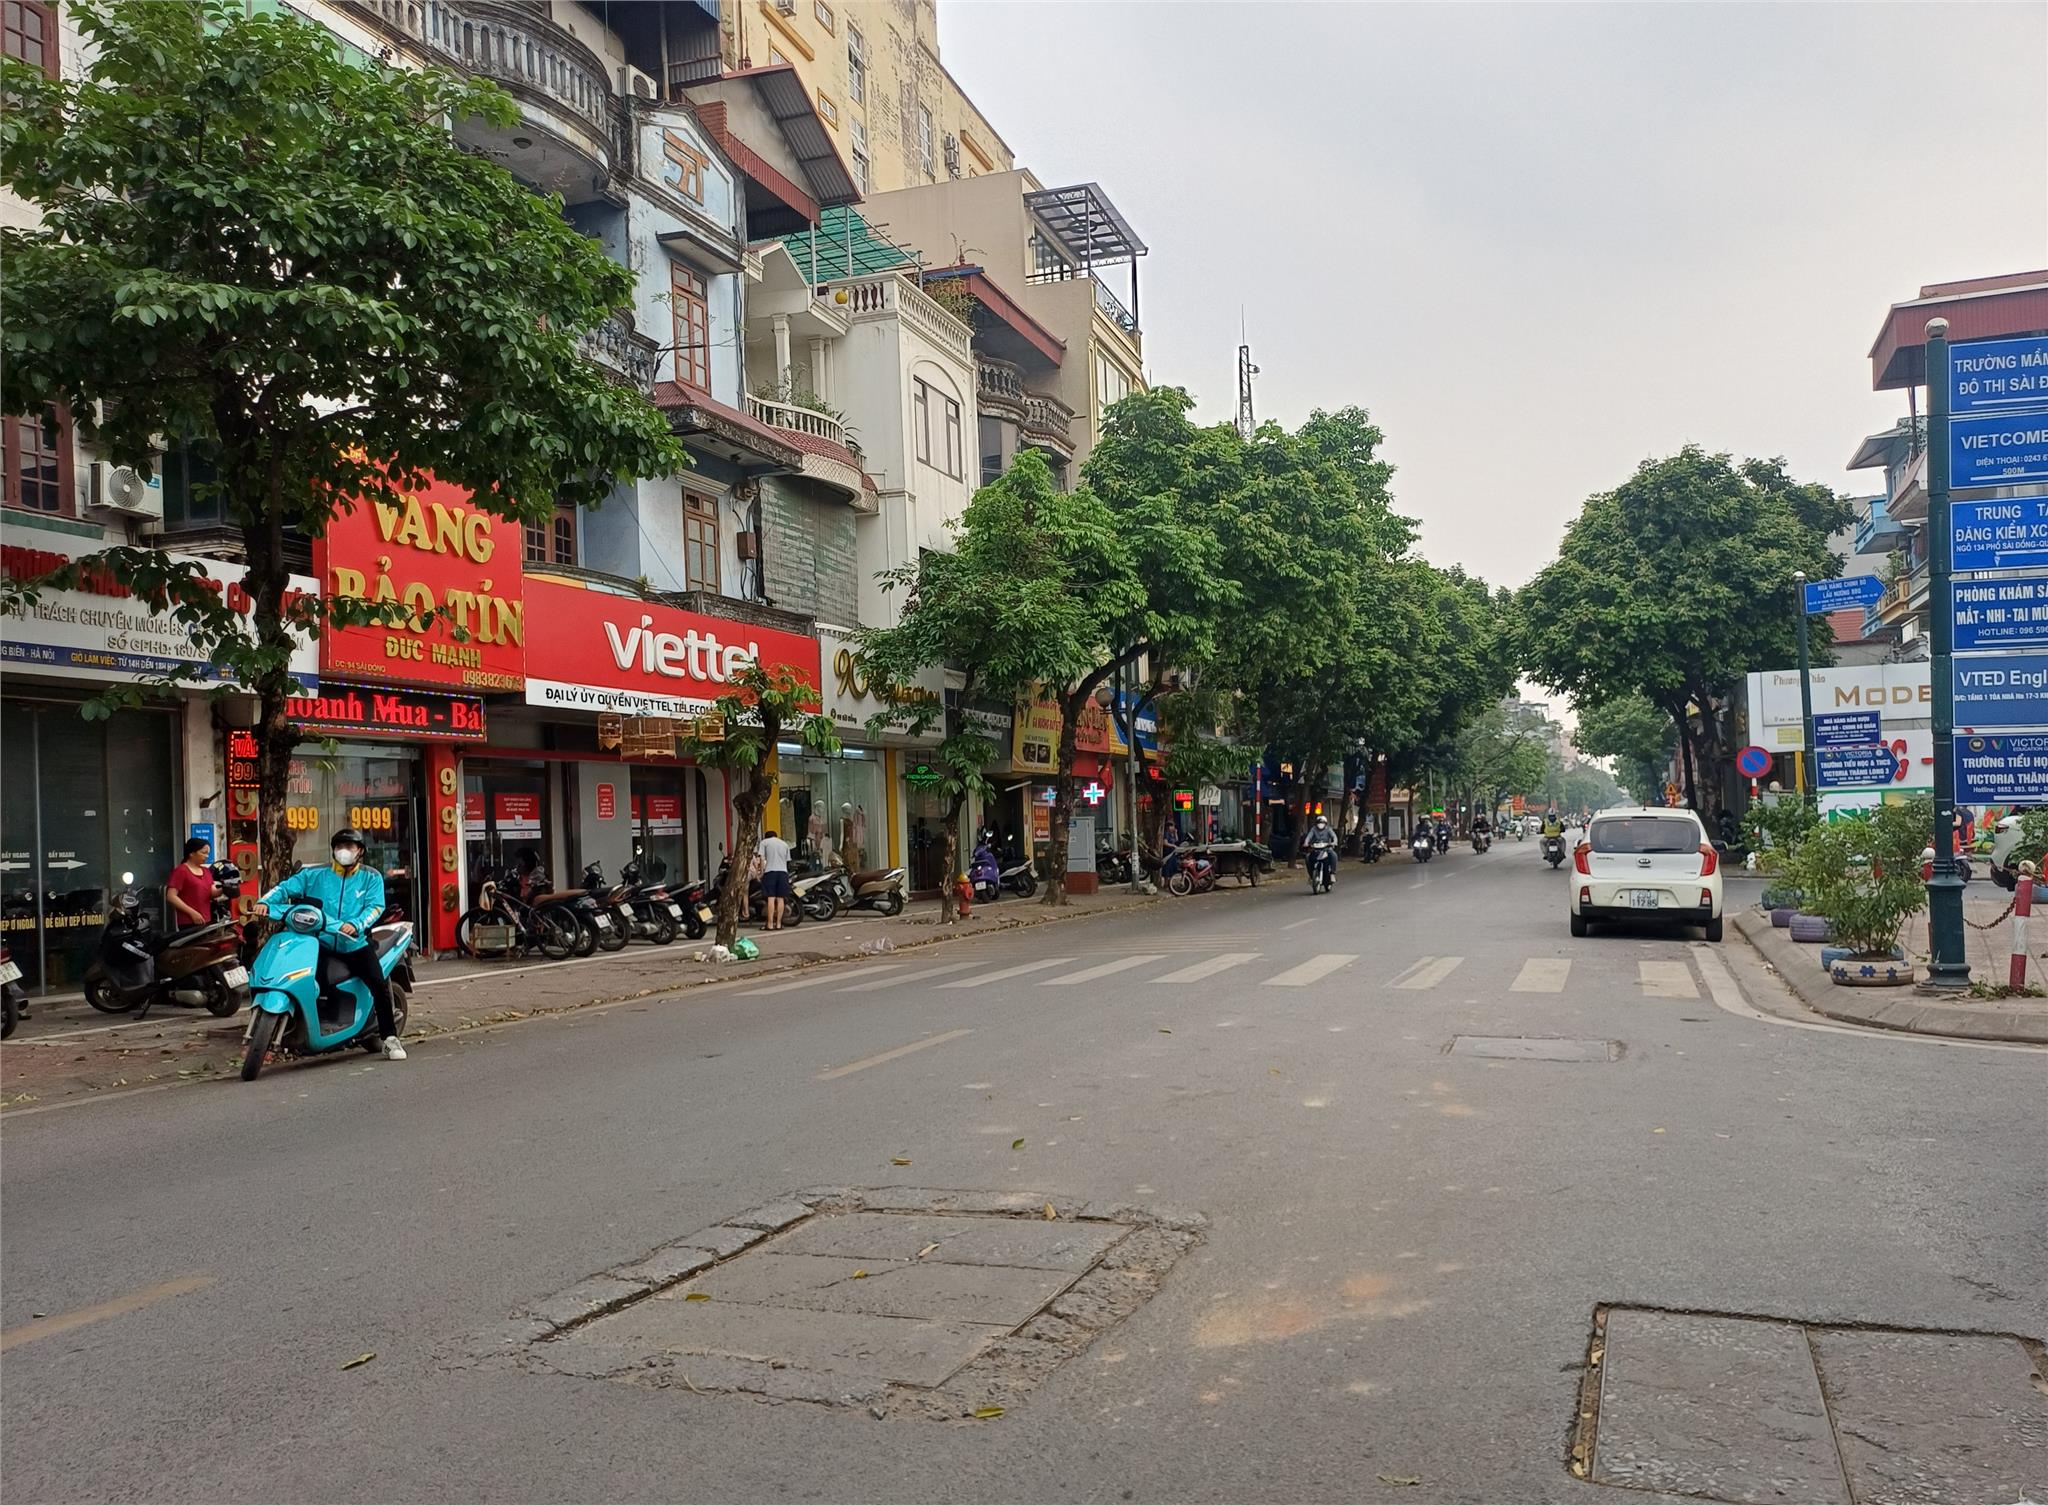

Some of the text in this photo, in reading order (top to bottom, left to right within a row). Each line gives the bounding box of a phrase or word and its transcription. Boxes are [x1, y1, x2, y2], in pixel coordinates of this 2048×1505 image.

[1954, 353, 2016, 373] TRƯỜNG
[1959, 378, 1979, 395] ĐÔ
[1983, 378, 2006, 395] THỊ
[2009, 374, 2034, 391] SÀI
[1976, 457, 1994, 467] ĐIỆN
[1975, 505, 2022, 520] TRUNG
[1956, 525, 1992, 542] ĐĂNG
[1996, 520, 2027, 540] KIỂM
[2002, 541, 2014, 550] SÀI
[1956, 586, 1996, 602] PHÒNG
[1999, 583, 2034, 601] KHÁM
[32, 601, 77, 624] TRÁCH
[80, 608, 133, 631] CHUYÊN
[1956, 605, 1979, 625] MẮT
[1986, 609, 2005, 623] NHI
[2013, 607, 2028, 622] TAI
[107, 631, 128, 650] SỐ
[31, 649, 41, 658] HÀ
[432, 643, 481, 670] MẠNH
[1960, 669, 2048, 688] VTED Engl
[546, 688, 564, 704] ĐẠI
[566, 687, 578, 702] LÝ
[580, 688, 595, 704] ỦY
[597, 692, 632, 708] QUYỀN
[373, 695, 428, 727] Mua
[1962, 755, 2005, 769] TRƯỜNG
[2007, 753, 2031, 768] TIỂU
[1823, 769, 1848, 777] VICTORIA
[1966, 773, 2015, 785] VICTORIA
[351, 806, 391, 829] 9999
